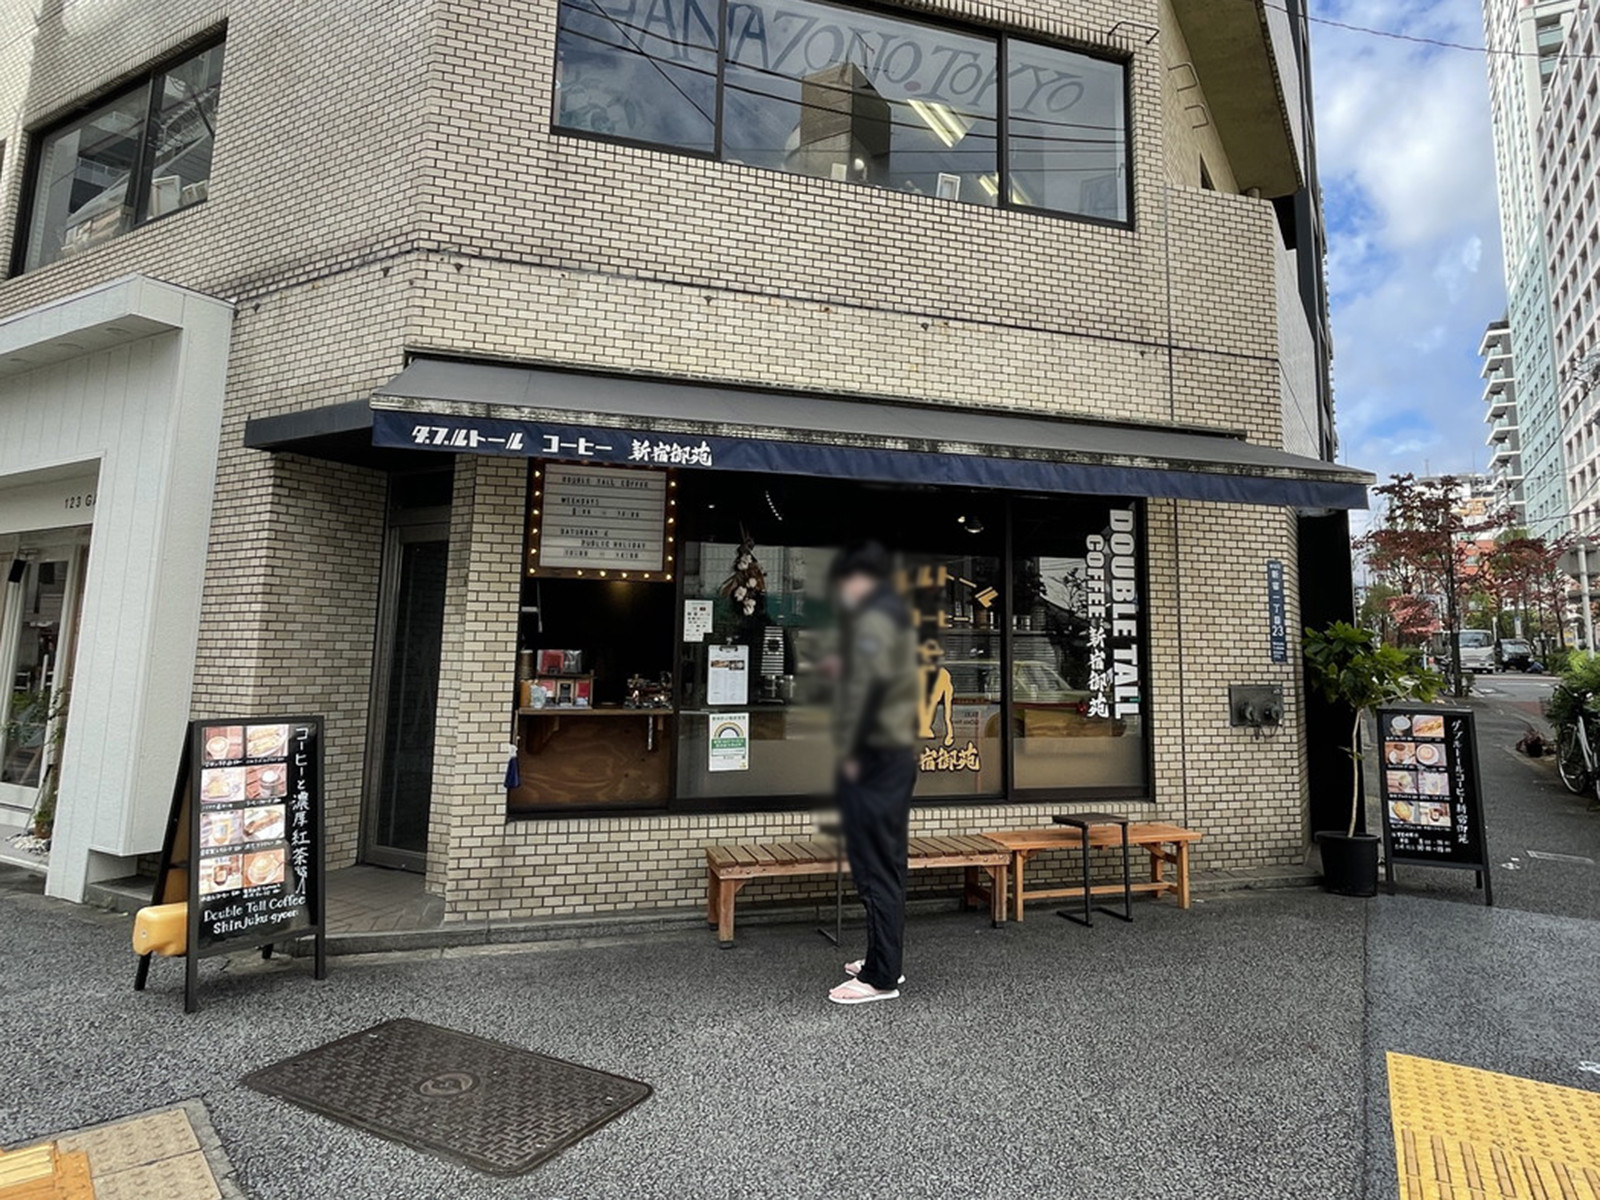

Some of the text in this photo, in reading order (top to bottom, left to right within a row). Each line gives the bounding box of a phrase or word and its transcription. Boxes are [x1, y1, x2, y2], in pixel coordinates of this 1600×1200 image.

[411, 425, 713, 467] ダブルトール コーヒー 新宿御苑
[64, 496, 82, 509] 123
[560, 497, 599, 506] WEEKDAYS
[560, 528, 599, 537] SATURDAY
[581, 539, 646, 550] PUBLIC HOLIDAY
[1109, 508, 1141, 720] DOUBLE TALL
[1085, 533, 1111, 719] COFFEE 新宿御苑
[1271, 624, 1285, 637] 23
[917, 741, 981, 771] 宿御苑
[203, 893, 306, 923] Double Tall Coffee
